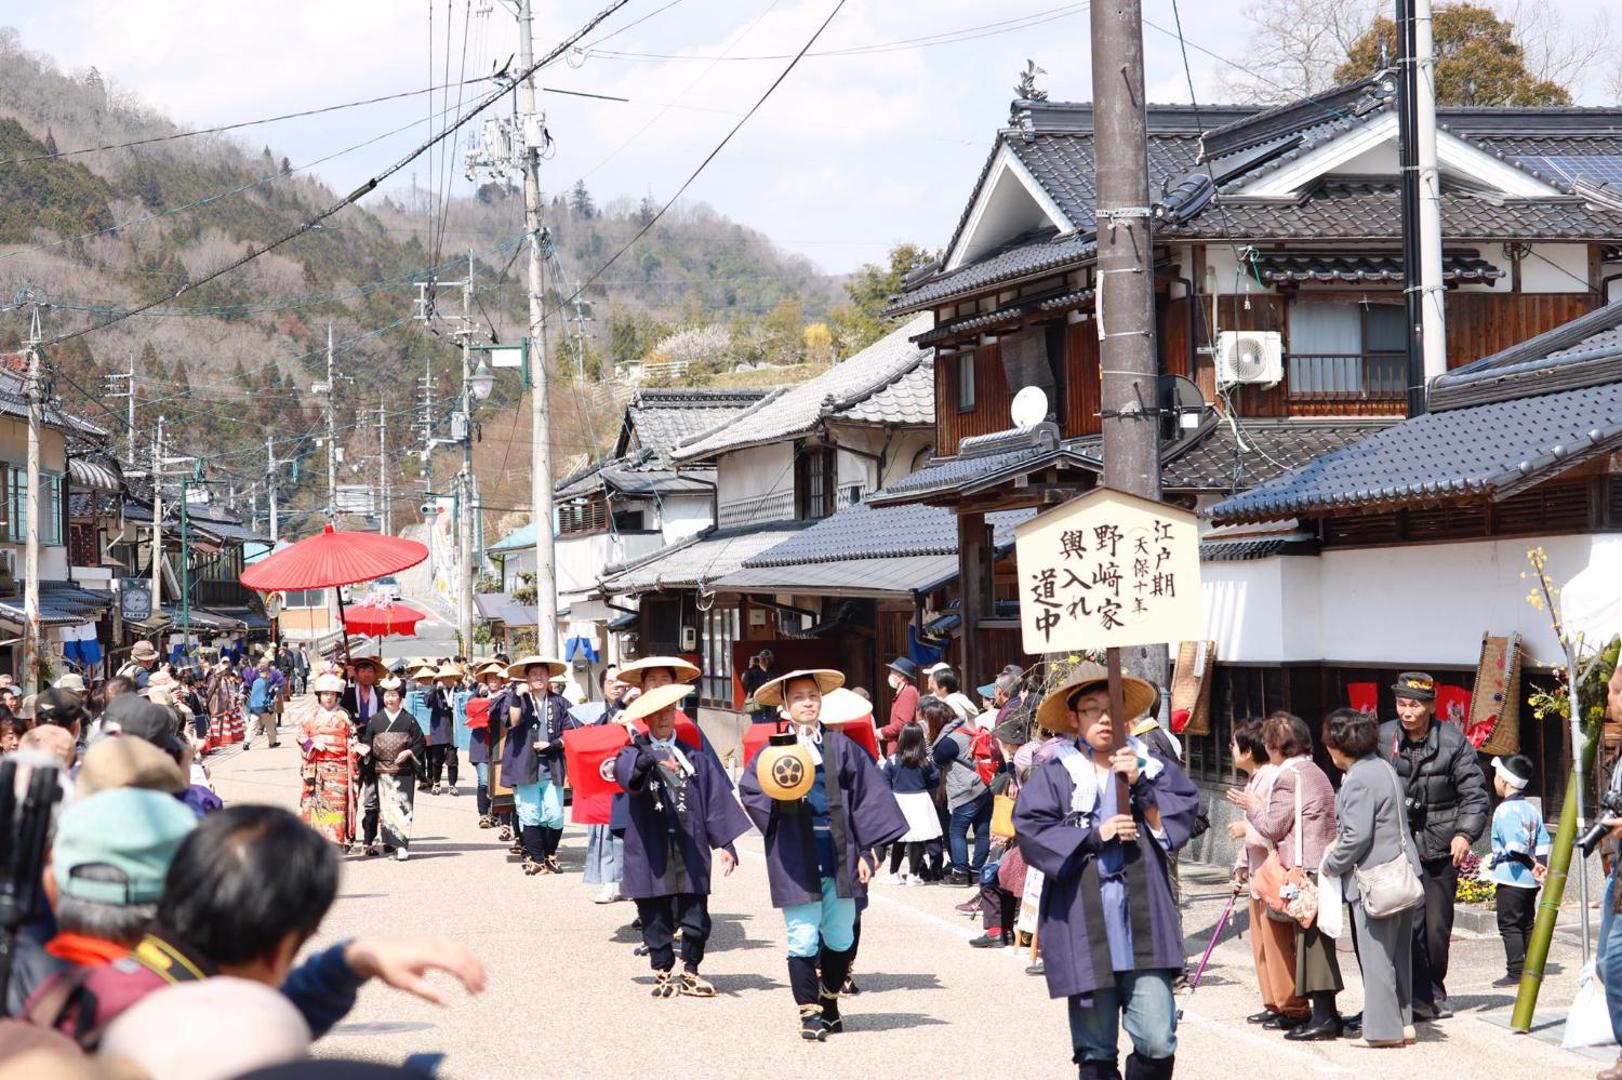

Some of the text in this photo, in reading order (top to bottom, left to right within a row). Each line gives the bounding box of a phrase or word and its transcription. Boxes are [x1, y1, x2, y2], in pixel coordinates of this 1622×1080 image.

[1150, 519, 1176, 598] 江戸期
[1029, 567, 1064, 645] 道中
